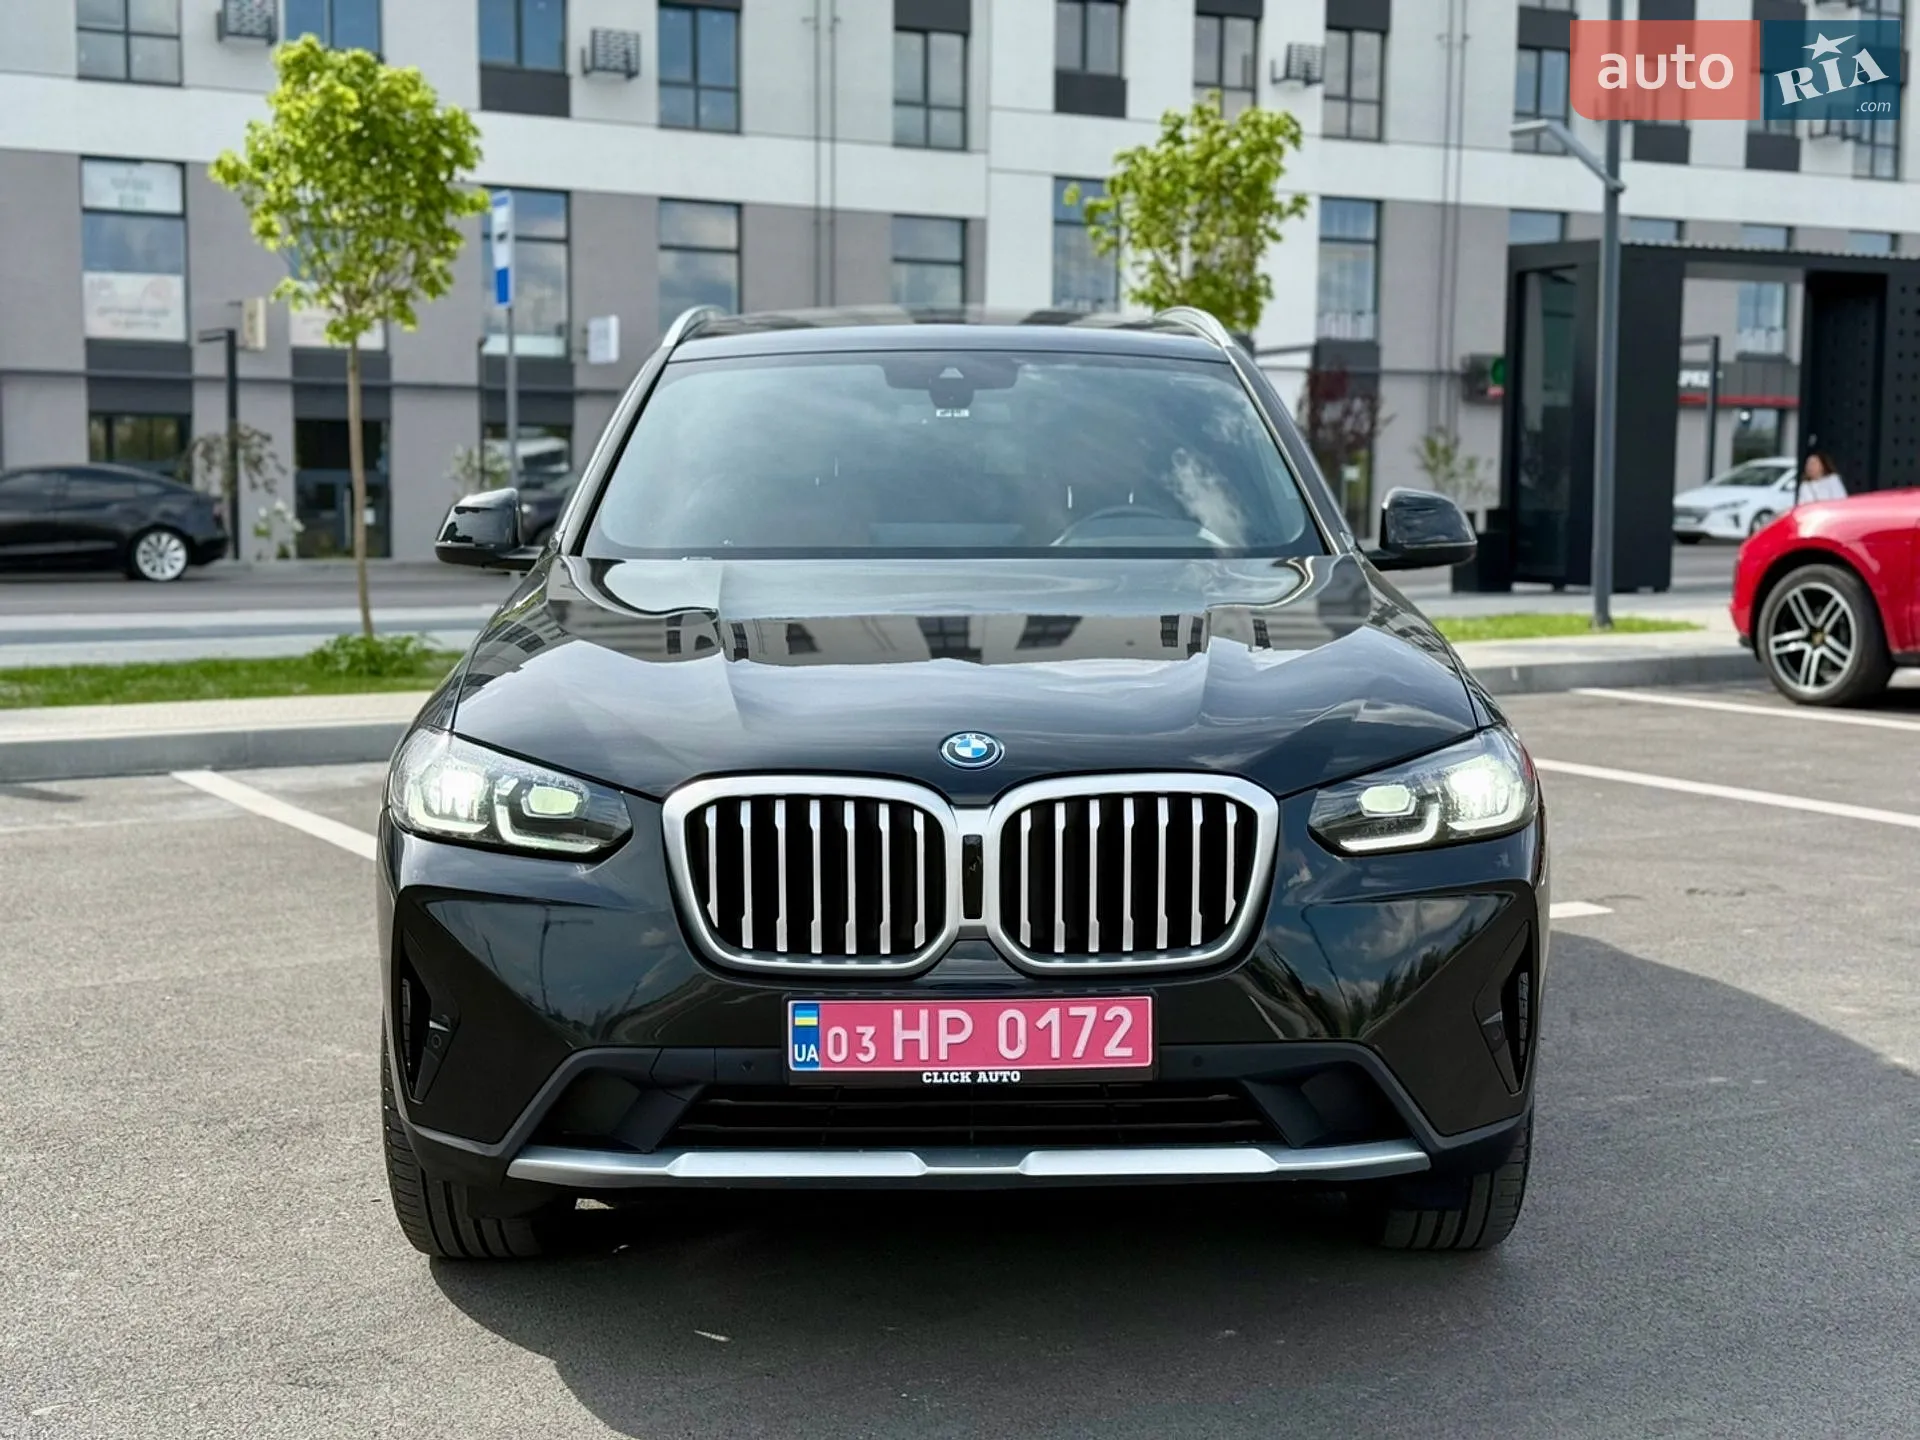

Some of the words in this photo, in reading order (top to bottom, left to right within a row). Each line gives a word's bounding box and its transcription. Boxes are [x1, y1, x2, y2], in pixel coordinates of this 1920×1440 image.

[827, 1026, 876, 1062] 03
[893, 1008, 973, 1061] HP
[998, 1006, 1133, 1059] 0172
[794, 1043, 819, 1062] UA
[922, 1072, 972, 1083] CLICK
[977, 1071, 1021, 1083] AUTO
